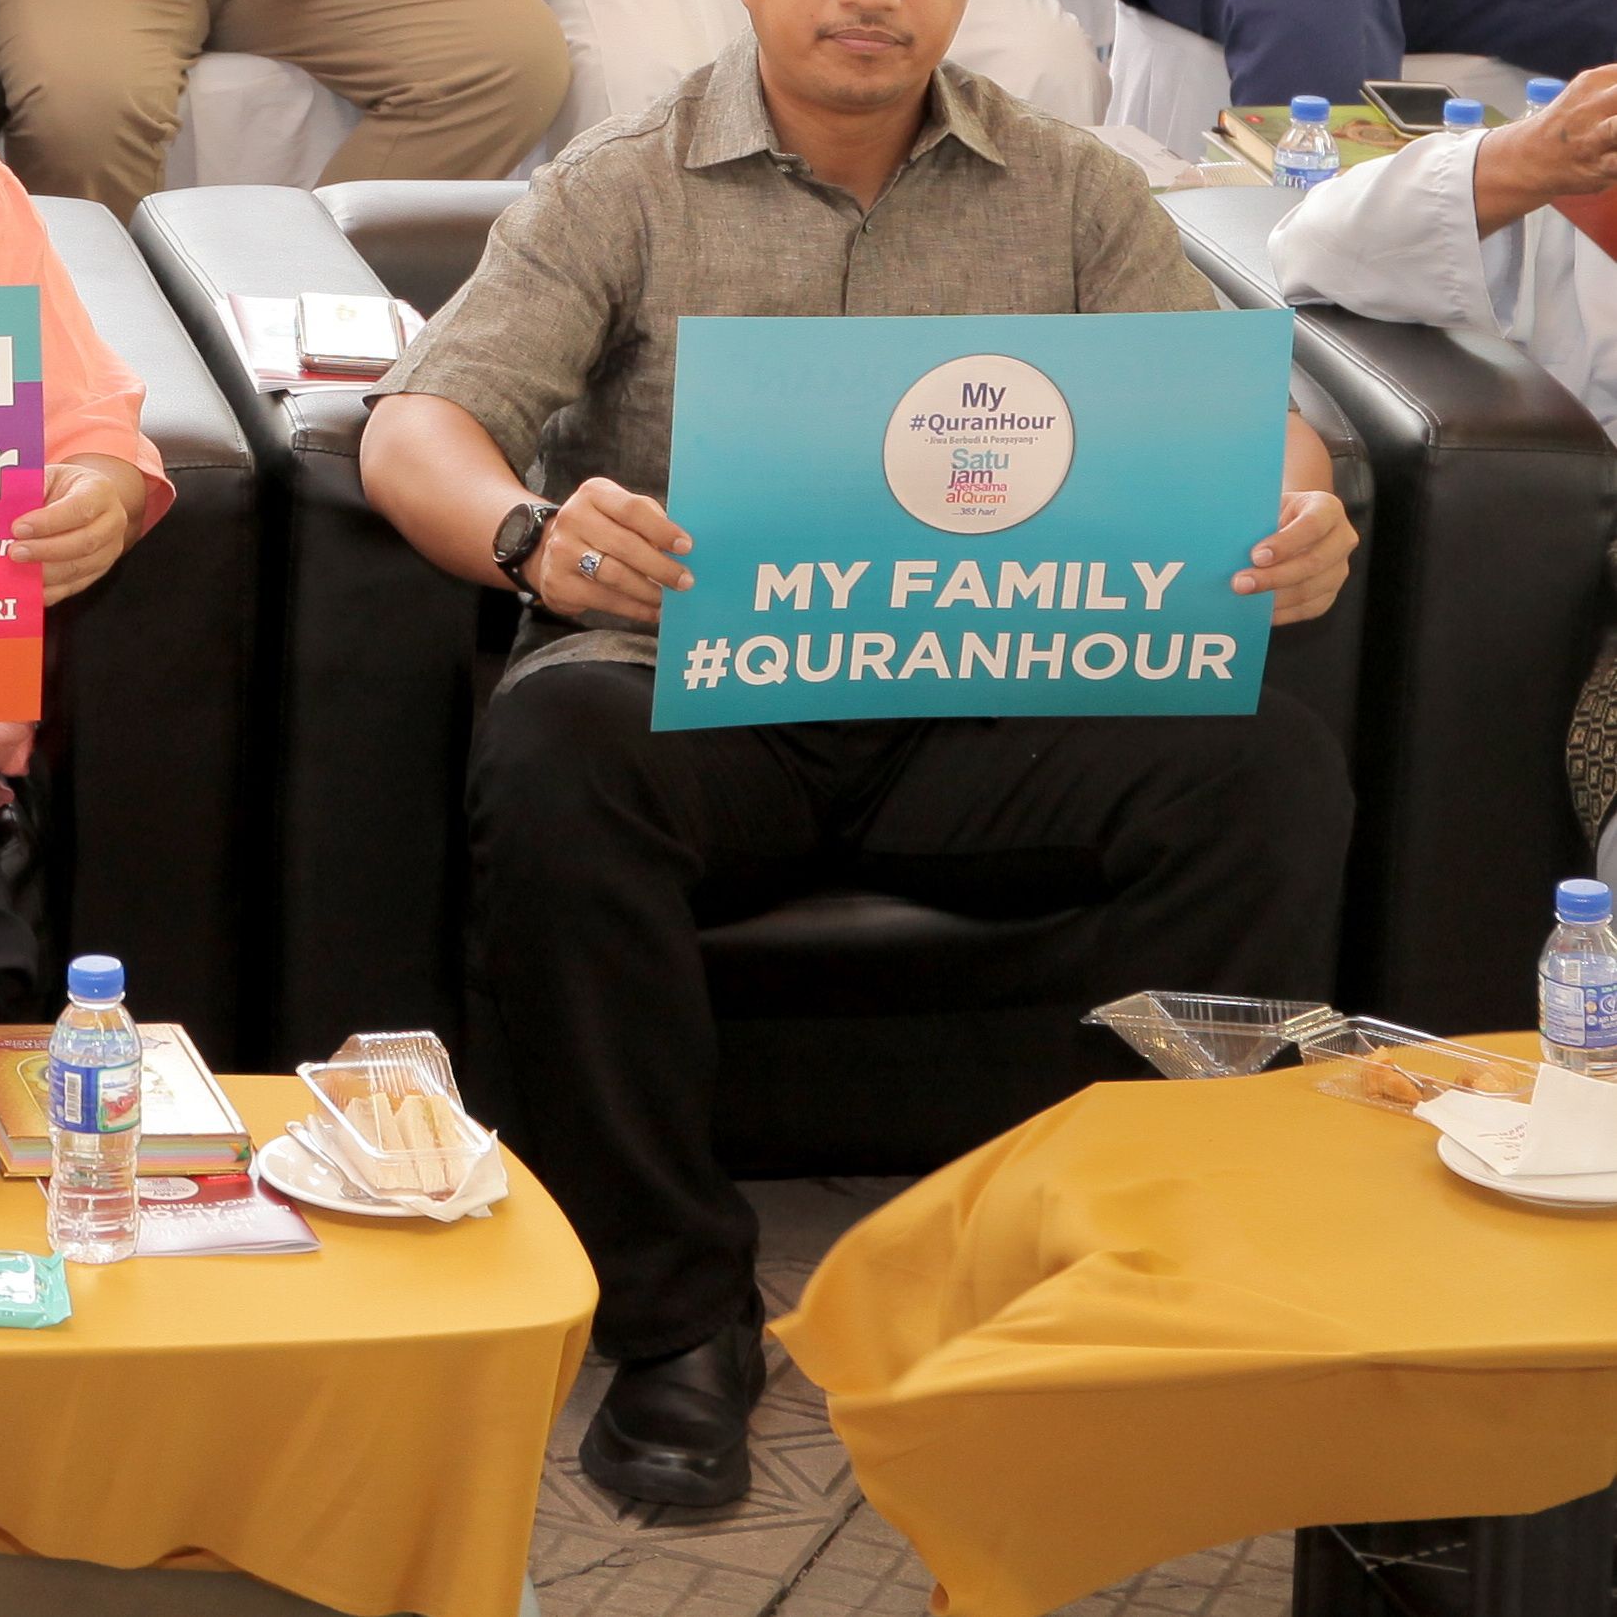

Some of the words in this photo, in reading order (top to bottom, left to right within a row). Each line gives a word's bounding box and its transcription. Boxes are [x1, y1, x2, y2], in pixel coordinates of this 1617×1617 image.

[961, 382, 1006, 412] My
[909, 413, 1056, 435] #QuranHour
[951, 448, 1009, 470] Satu
[947, 466, 993, 489] jam
[753, 561, 871, 611] MY
[889, 559, 1185, 611] FAMILY
[682, 631, 1238, 690] #QURANHOUR
